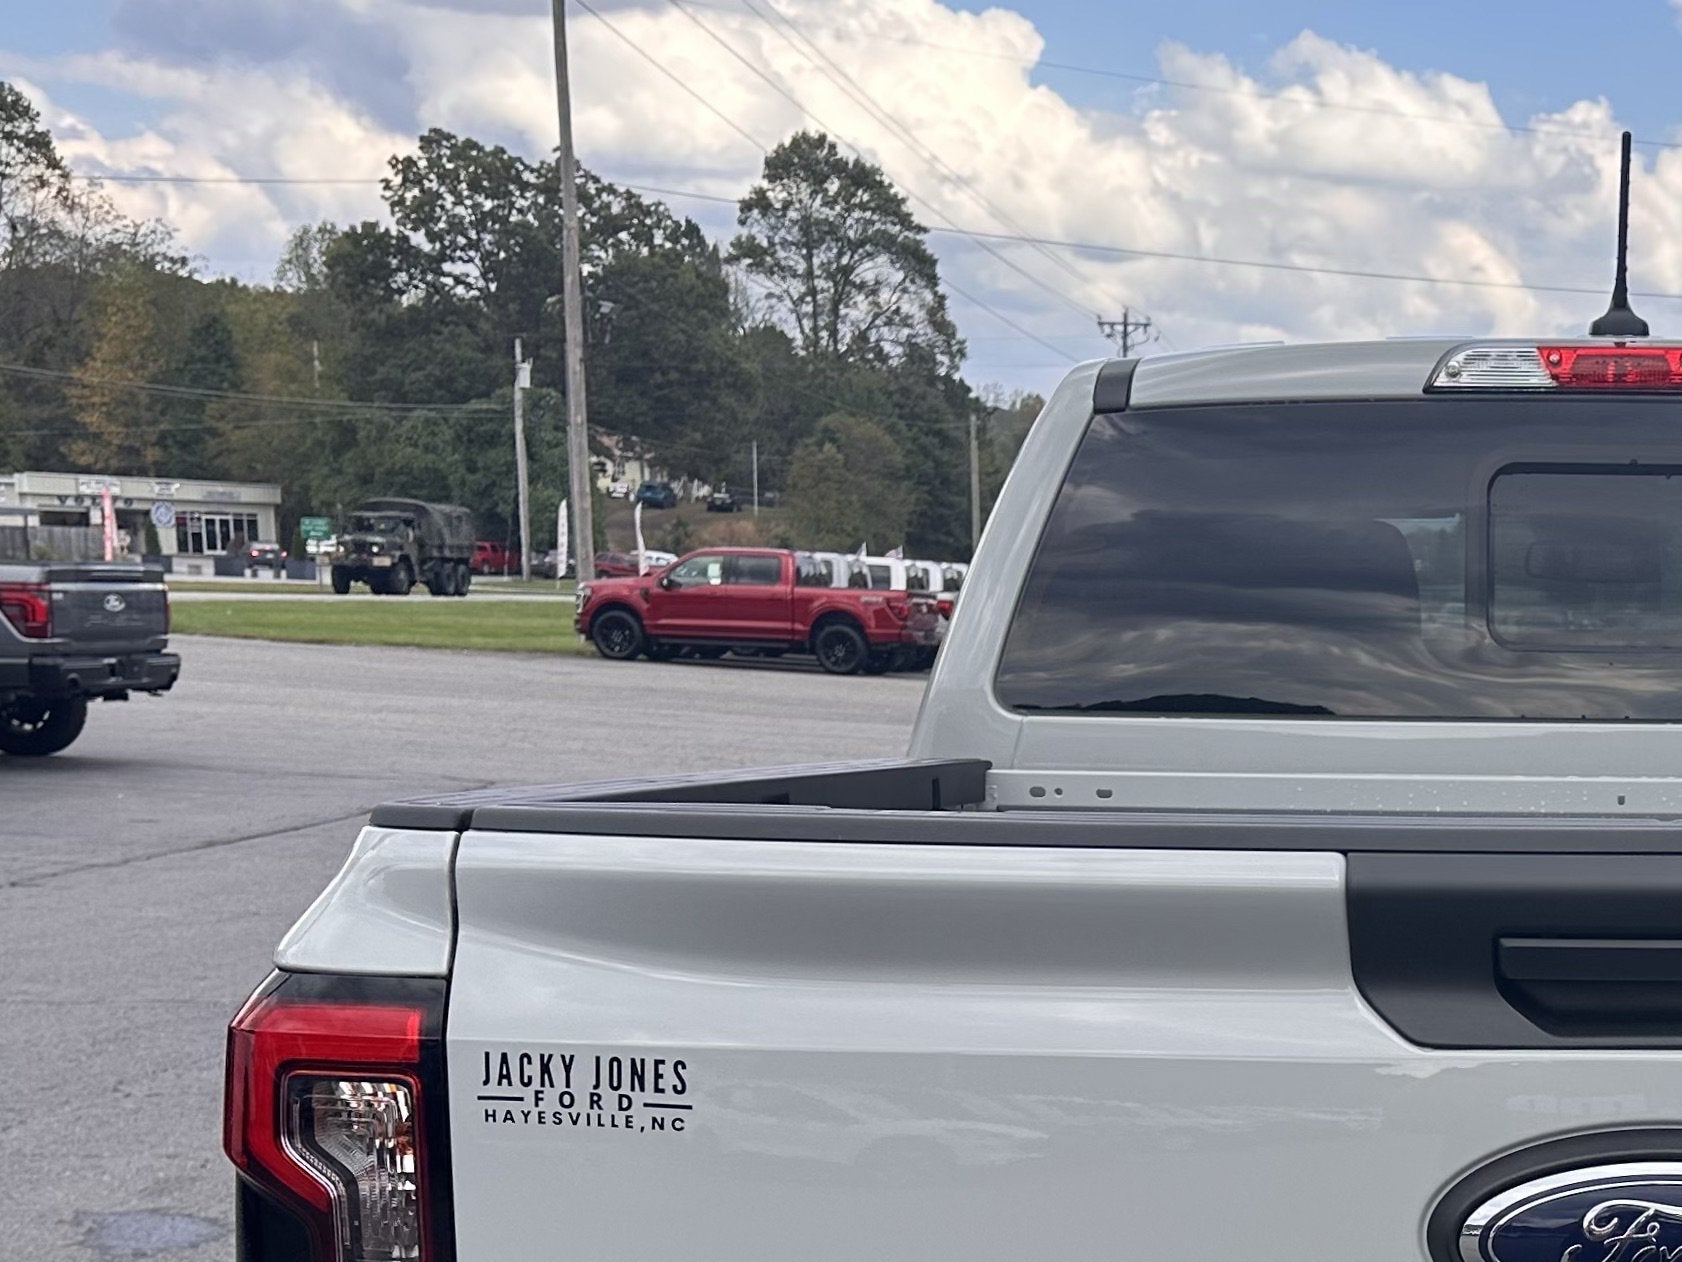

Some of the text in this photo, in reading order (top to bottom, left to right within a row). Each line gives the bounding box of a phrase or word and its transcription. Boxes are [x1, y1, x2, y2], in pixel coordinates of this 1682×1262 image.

[482, 1051, 688, 1095] JACKY JONES
[534, 1090, 633, 1111] FORD
